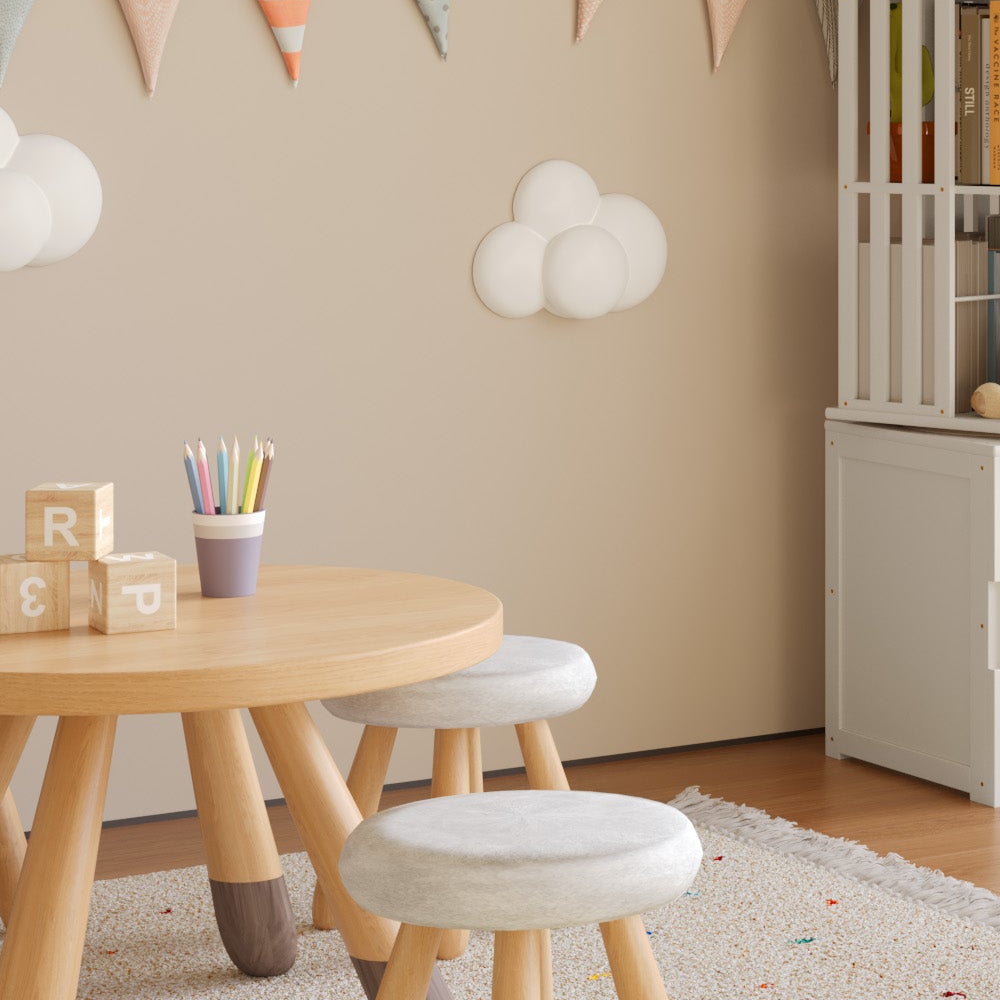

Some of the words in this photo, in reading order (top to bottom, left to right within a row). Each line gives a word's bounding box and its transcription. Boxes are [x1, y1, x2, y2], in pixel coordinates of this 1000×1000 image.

[964, 87, 975, 116] STILL
[44, 506, 80, 547] R
[122, 584, 161, 614] P
